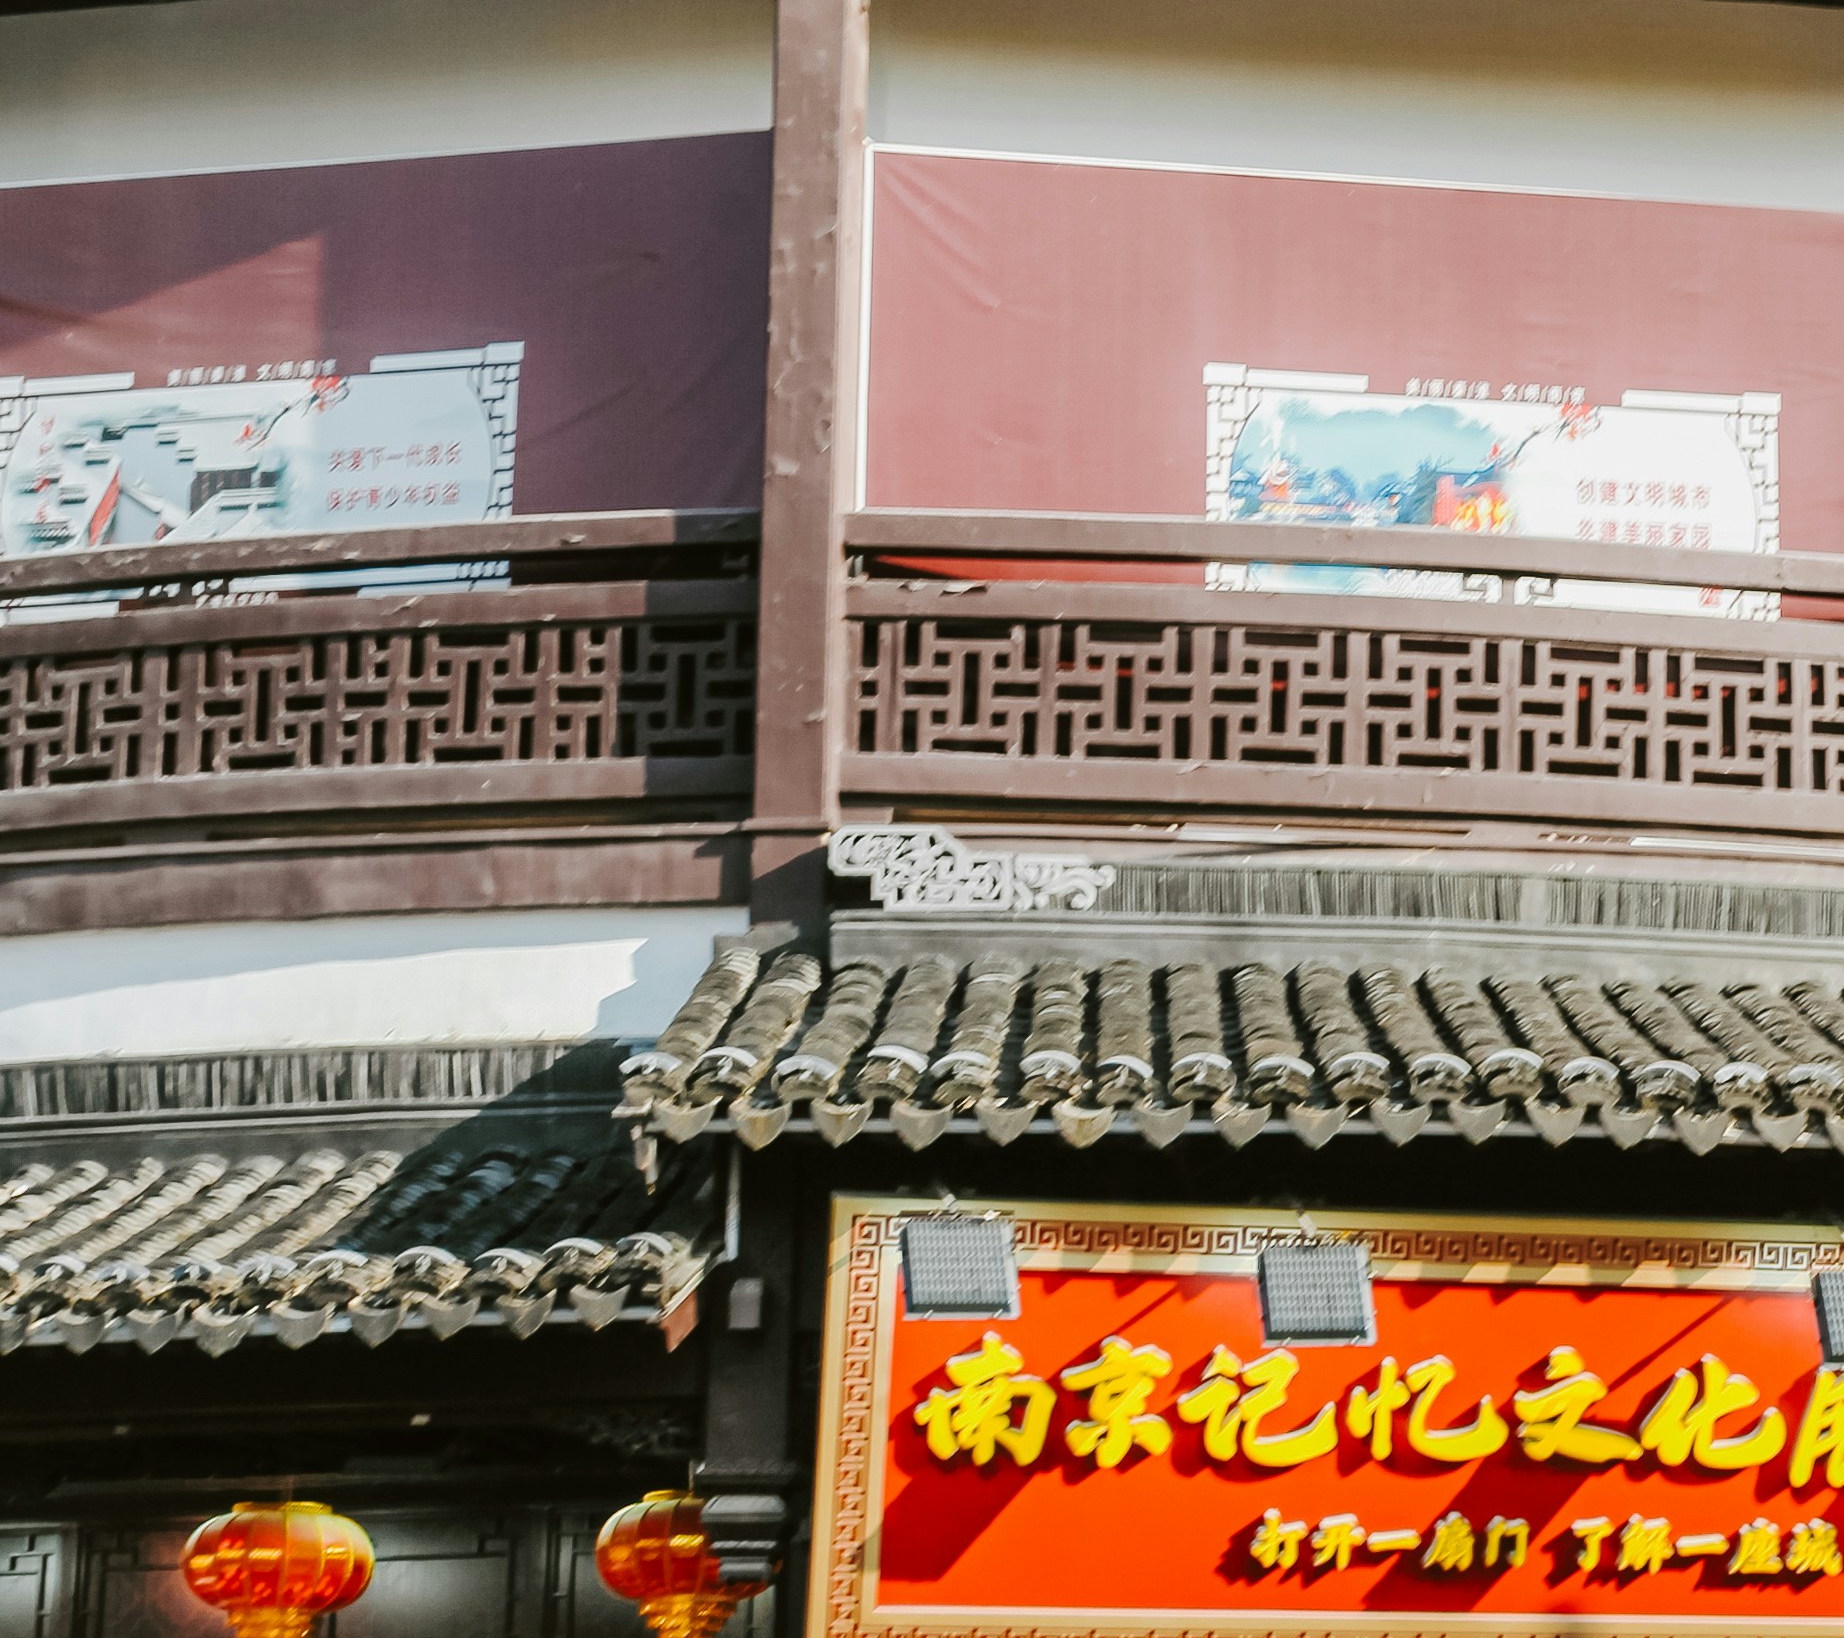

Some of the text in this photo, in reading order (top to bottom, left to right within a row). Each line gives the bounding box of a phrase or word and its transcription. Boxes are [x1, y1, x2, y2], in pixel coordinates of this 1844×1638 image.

[1576, 478, 1712, 510] 创建文明城市
[1249, 1507, 1843, 1576] 打开一扇门 了解一座城
